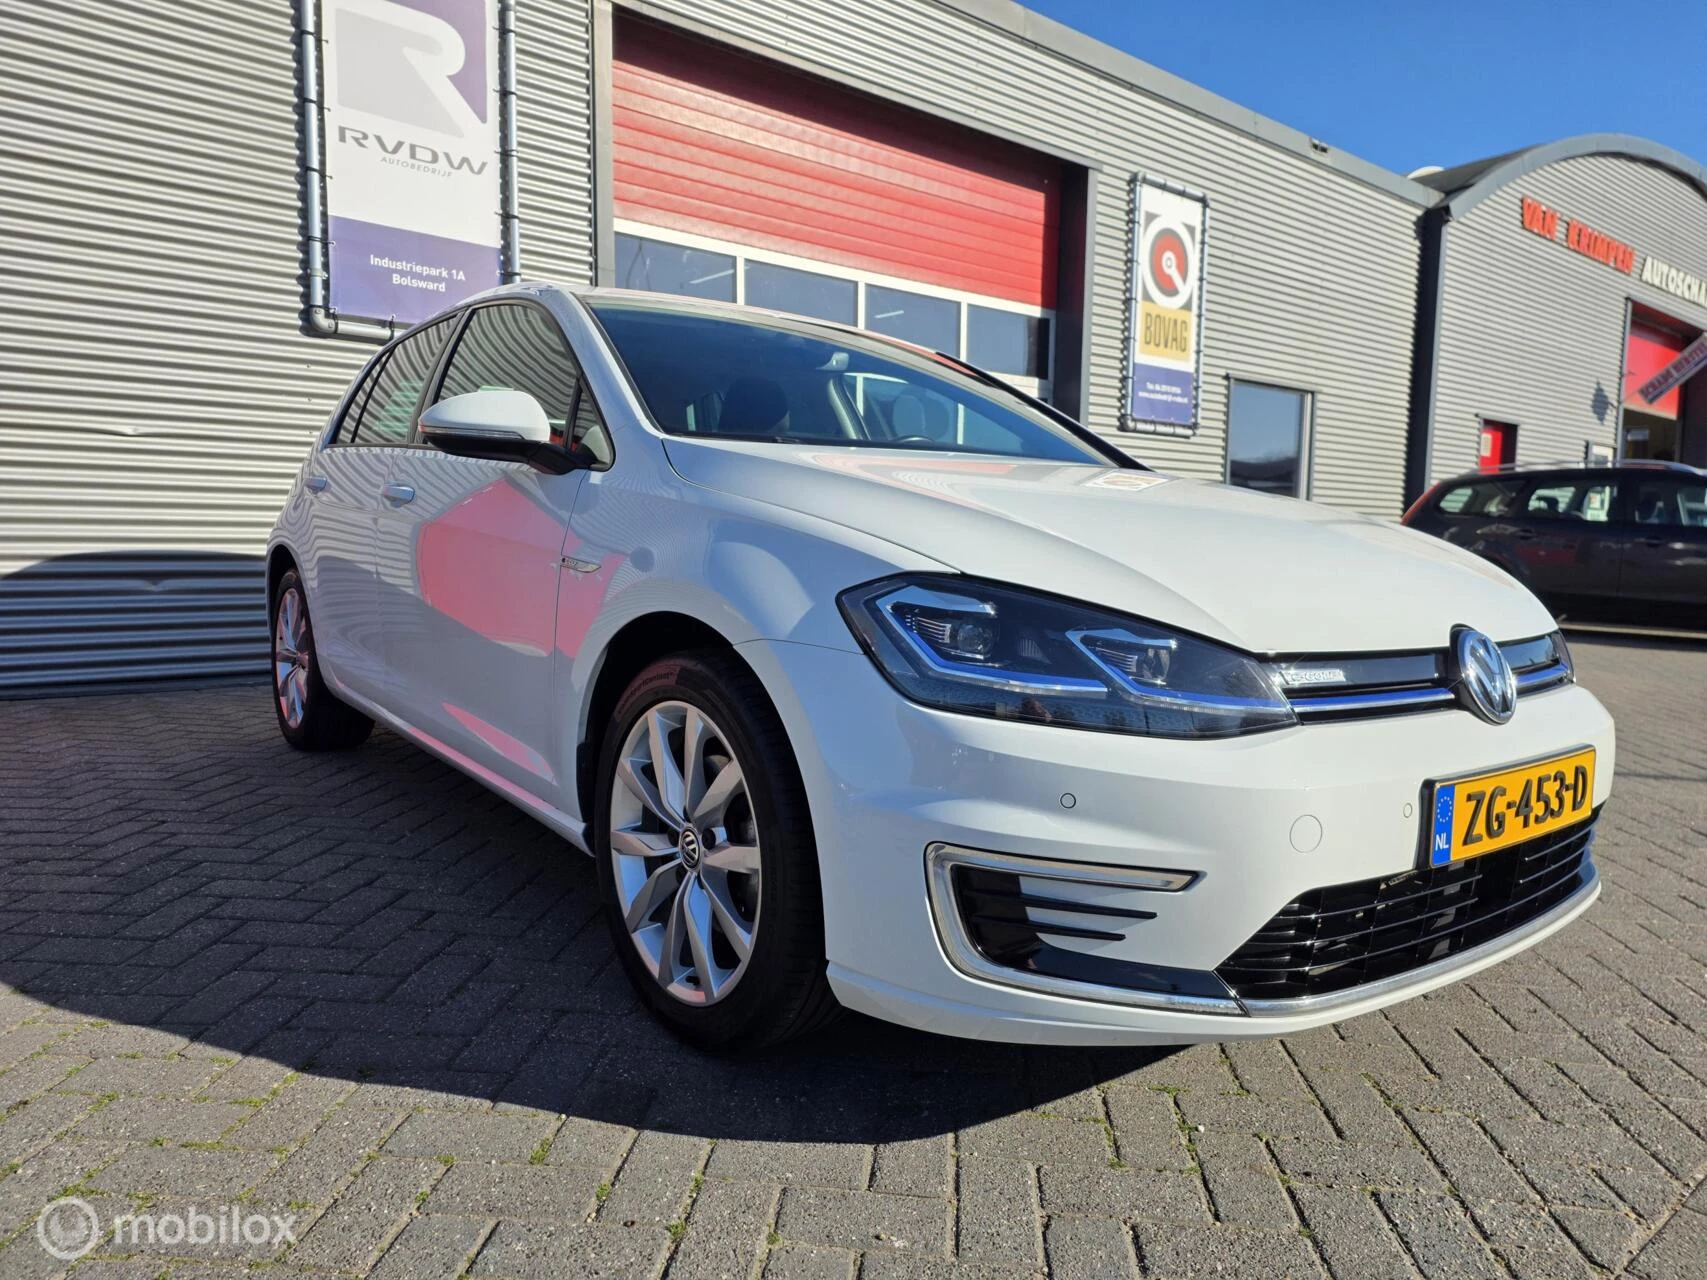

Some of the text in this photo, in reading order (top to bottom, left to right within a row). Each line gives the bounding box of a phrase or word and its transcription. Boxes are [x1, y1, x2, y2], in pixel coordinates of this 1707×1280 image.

[338, 125, 488, 176] RVDW
[380, 156, 453, 178] AUTOBEDRIJF
[1521, 194, 1560, 242] VAN
[370, 254, 466, 282] Industriepark 1A
[392, 273, 446, 292] Bolsward
[1144, 311, 1188, 353] BOVAG
[1462, 765, 1588, 847] ZG-453-D
[1435, 832, 1450, 852] NL
